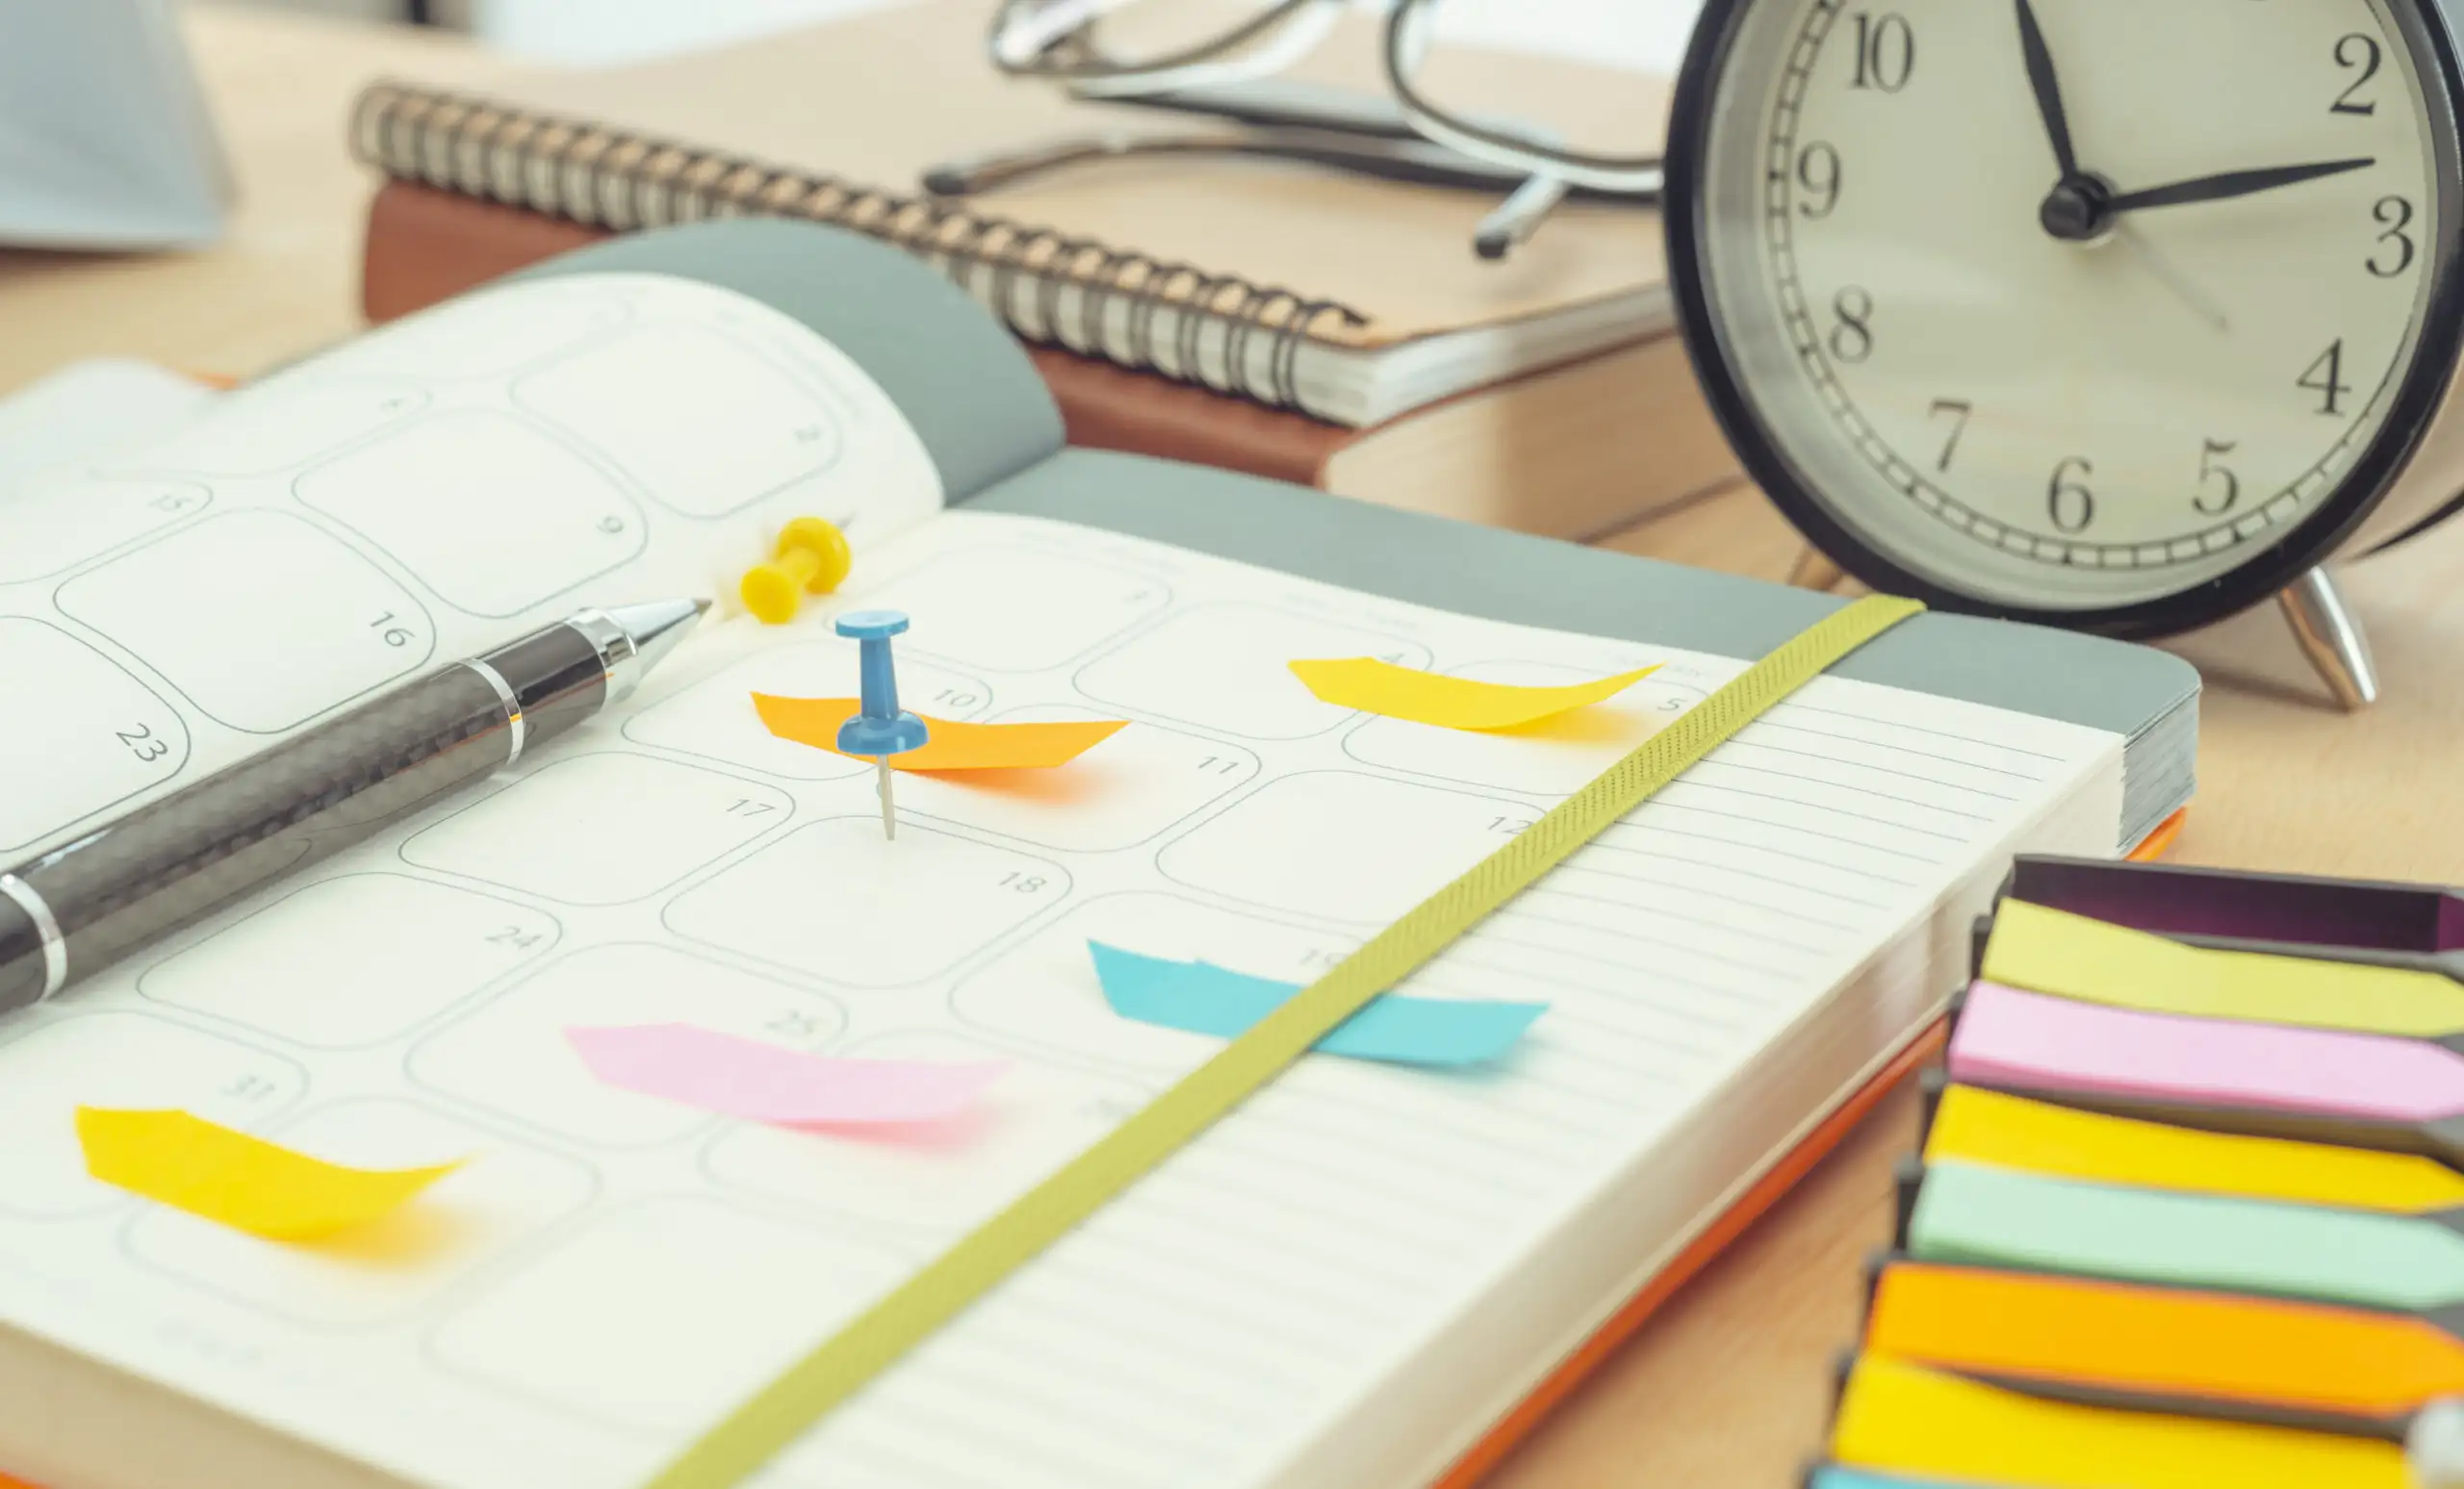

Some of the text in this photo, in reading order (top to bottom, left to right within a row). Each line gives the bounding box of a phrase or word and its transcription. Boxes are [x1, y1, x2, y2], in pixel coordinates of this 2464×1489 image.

[1852, 13, 1914, 93] 10
[2328, 33, 2381, 116] 2
[1796, 141, 1841, 218] 9
[2364, 195, 2414, 278] 3
[1828, 284, 1875, 363] 8
[2296, 336, 2352, 418] 4
[1927, 396, 1974, 474] 7
[2045, 455, 2096, 536] 6
[2192, 436, 2243, 517] 5
[148, 493, 194, 512] 15
[596, 516, 625, 535] 9
[370, 610, 417, 649] 16
[933, 688, 978, 706] 10
[1656, 697, 1688, 711] 5
[115, 721, 169, 763] 23
[1197, 755, 1241, 774] 11
[726, 798, 777, 818] 17
[1486, 815, 1534, 835] 12
[998, 871, 1048, 894] 18
[483, 925, 544, 950] 24
[764, 1008, 823, 1038] 25
